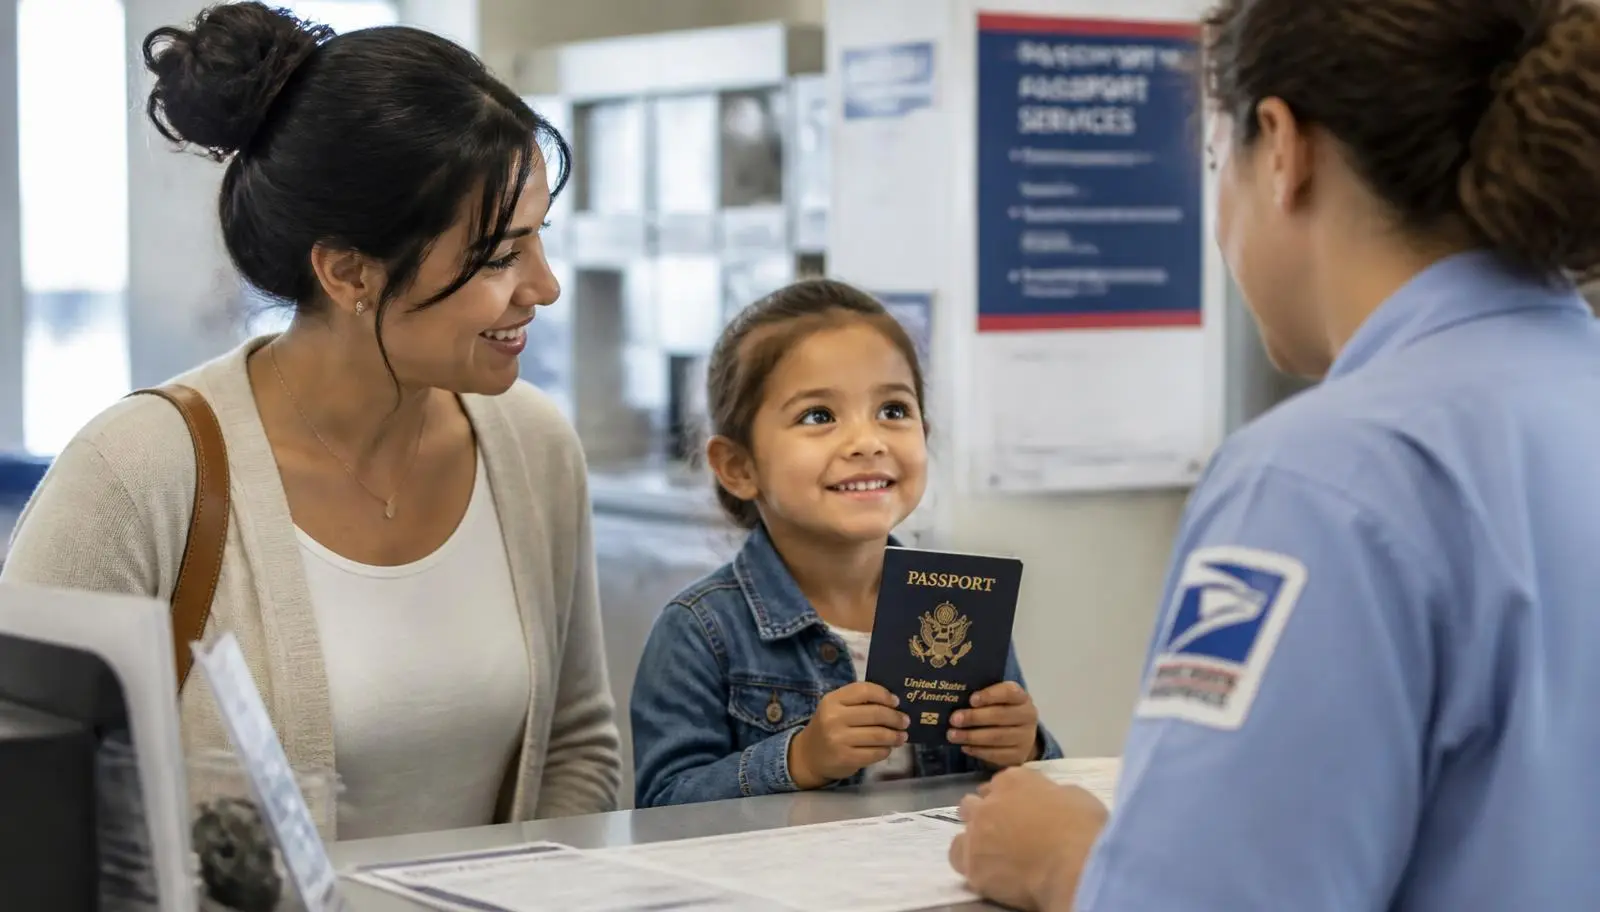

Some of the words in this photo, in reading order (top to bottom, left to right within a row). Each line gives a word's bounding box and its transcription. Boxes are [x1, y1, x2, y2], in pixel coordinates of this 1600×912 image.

[1018, 106, 1135, 134] SERVICES
[907, 570, 996, 592] PASSPORT
[904, 678, 937, 690] United
[938, 679, 967, 691] States
[907, 690, 919, 702] of
[920, 691, 958, 703] America
